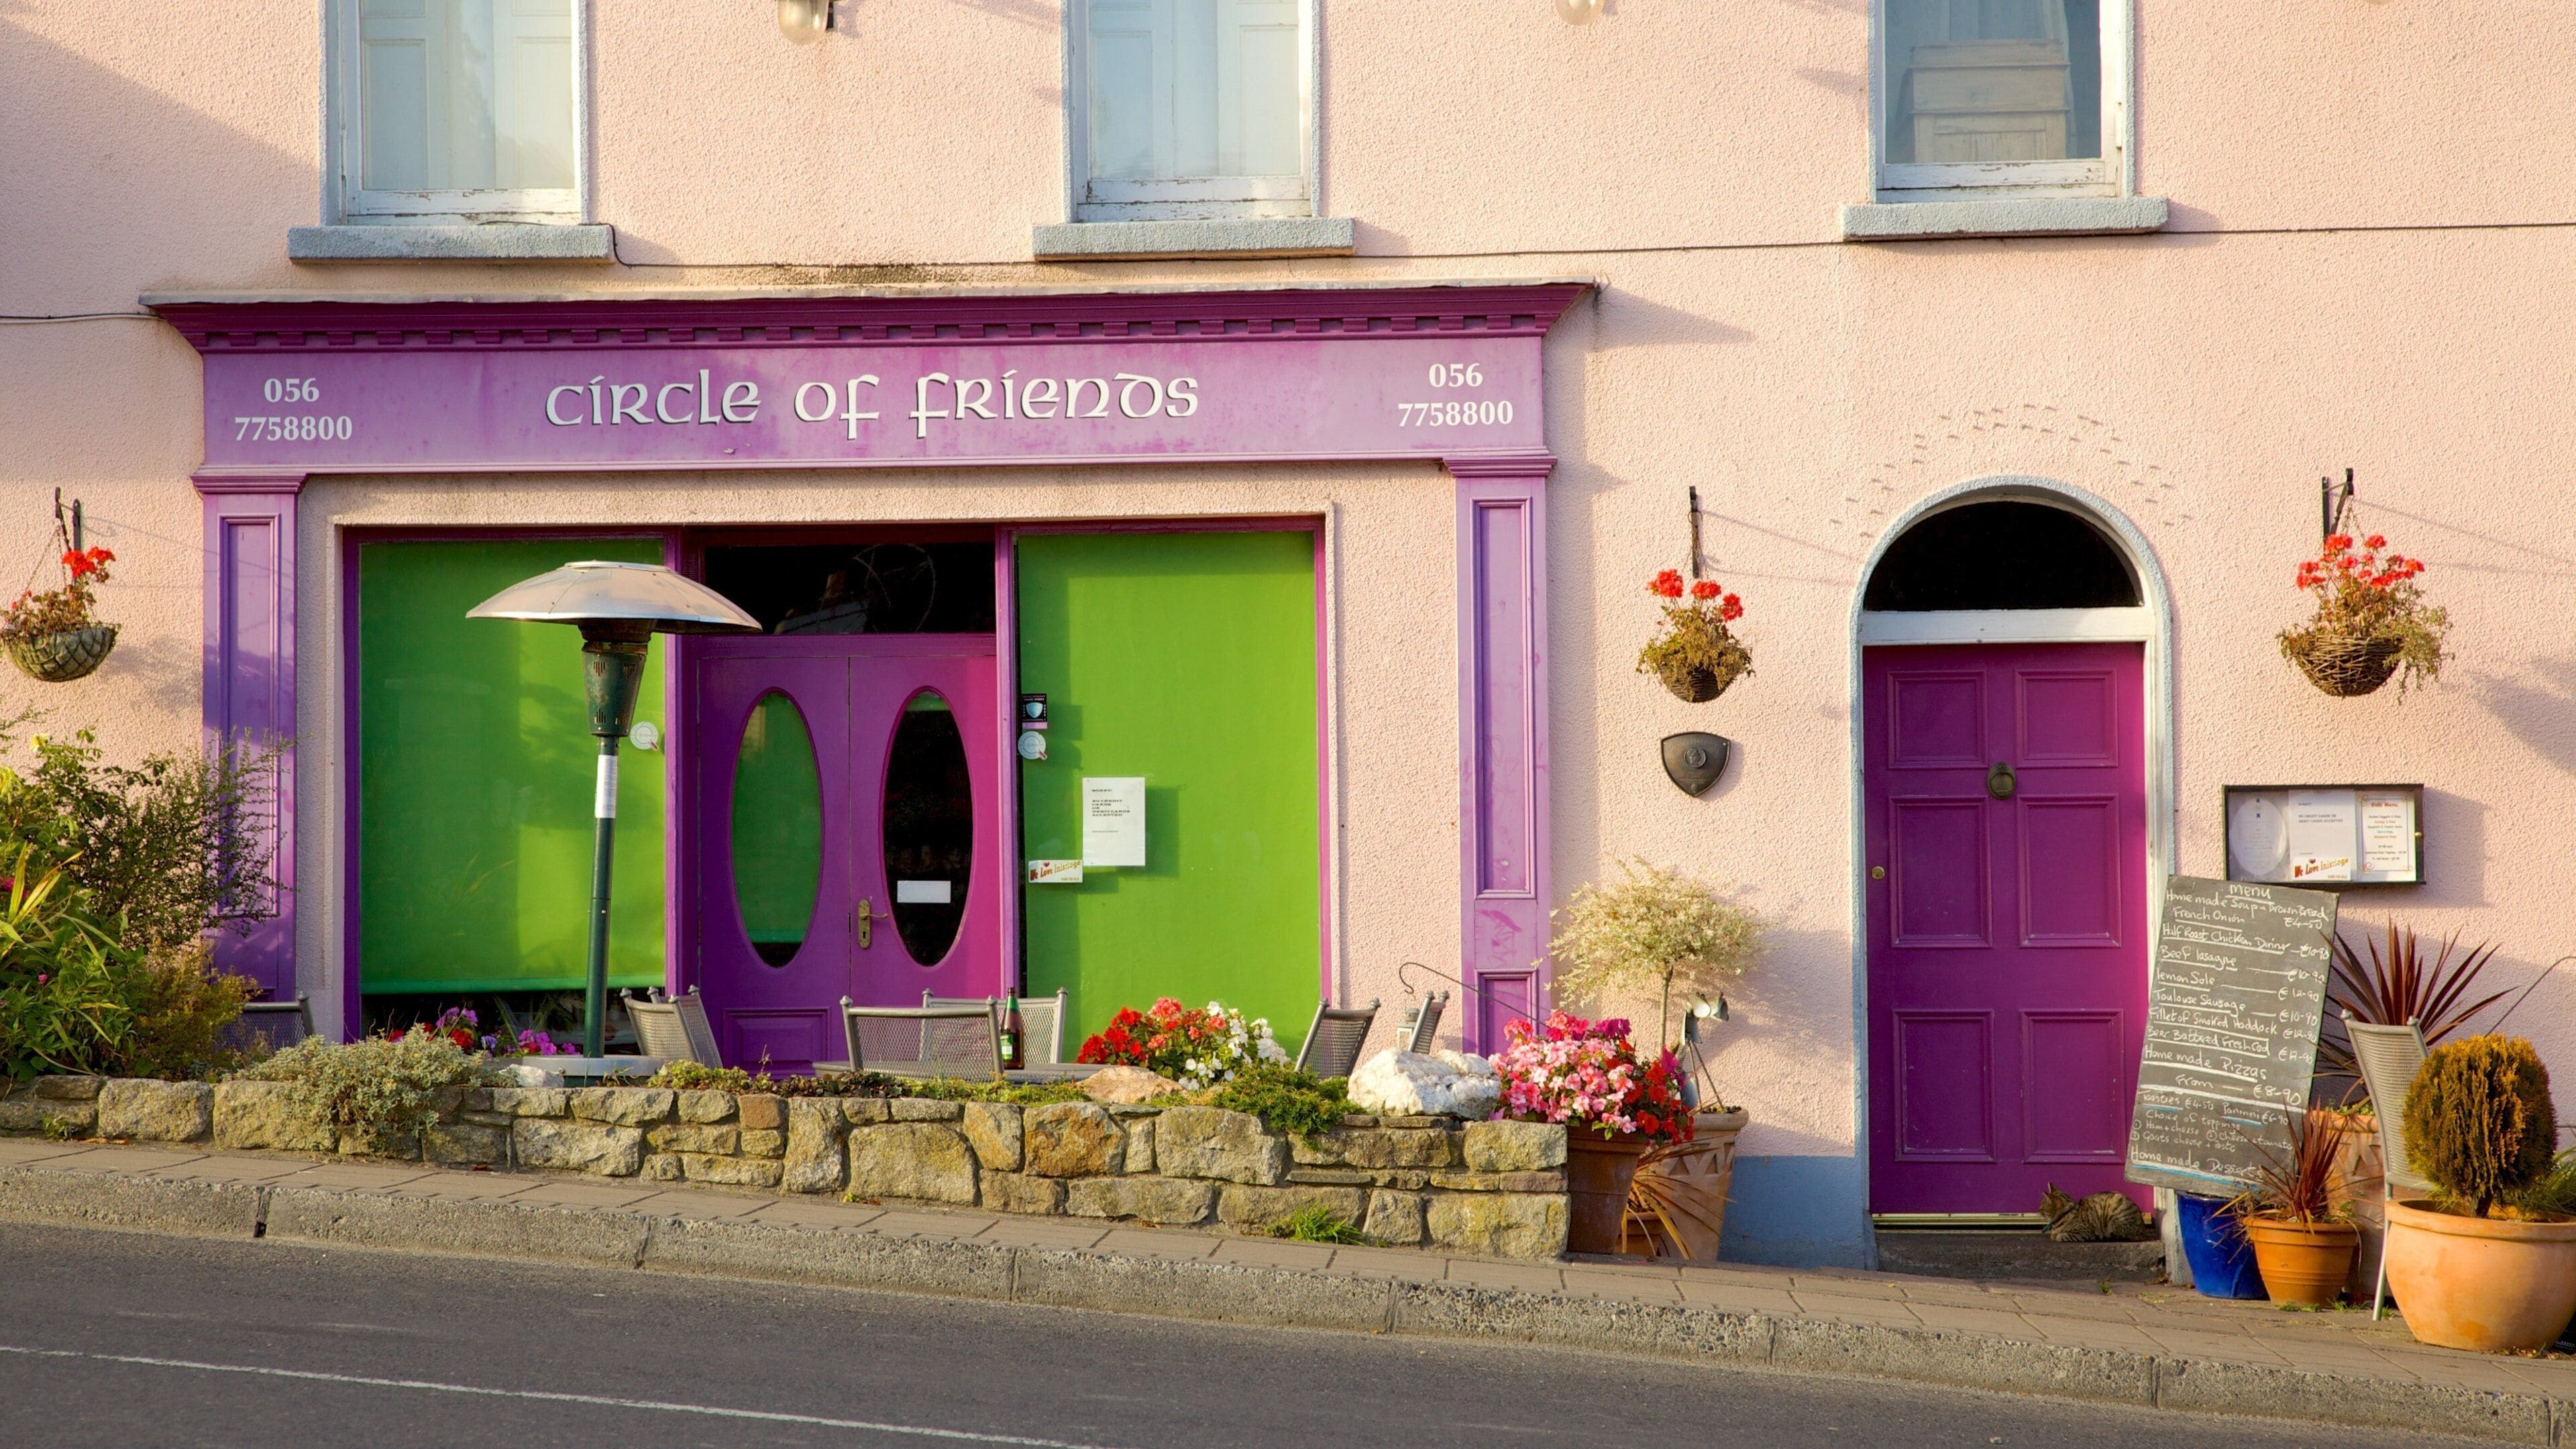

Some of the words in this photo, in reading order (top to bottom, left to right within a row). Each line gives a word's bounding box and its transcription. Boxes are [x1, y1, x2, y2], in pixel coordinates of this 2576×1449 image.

[1428, 362, 1484, 388] 056
[264, 378, 320, 403] 056
[1397, 400, 1513, 427] 7758800
[234, 415, 353, 441] 7758800
[1040, 867, 1053, 878] Love
[2305, 863, 2319, 875] Love
[2166, 888, 2192, 902] Home
[2195, 892, 2228, 908] made
[2173, 906, 2210, 920] French
[2212, 910, 2245, 924] Onion
[2162, 922, 2184, 938] Half
[2184, 926, 2210, 941] Roast
[2211, 931, 2252, 947] Chicken
[2159, 945, 2191, 960] Beef
[2190, 971, 2215, 985] Sole
[2153, 987, 2197, 1004] Toulouse
[2200, 994, 2246, 1018] Sausage
[2178, 1010, 2190, 1023] of
[2233, 1017, 2278, 1035] Haddock
[2147, 1025, 2171, 1038] Beer
[2172, 1028, 2220, 1046] Battered
[2145, 1043, 2174, 1059] Home
[2176, 1050, 2212, 1068] made
[2220, 1056, 2267, 1080] Pizzas
[2175, 1073, 2214, 1089] From
[2146, 1110, 2178, 1121] Choice
[2184, 1113, 2198, 1123] of
[2146, 1119, 2163, 1130] Ham
[2131, 1144, 2162, 1161] Home
[2167, 1148, 2200, 1171] made
